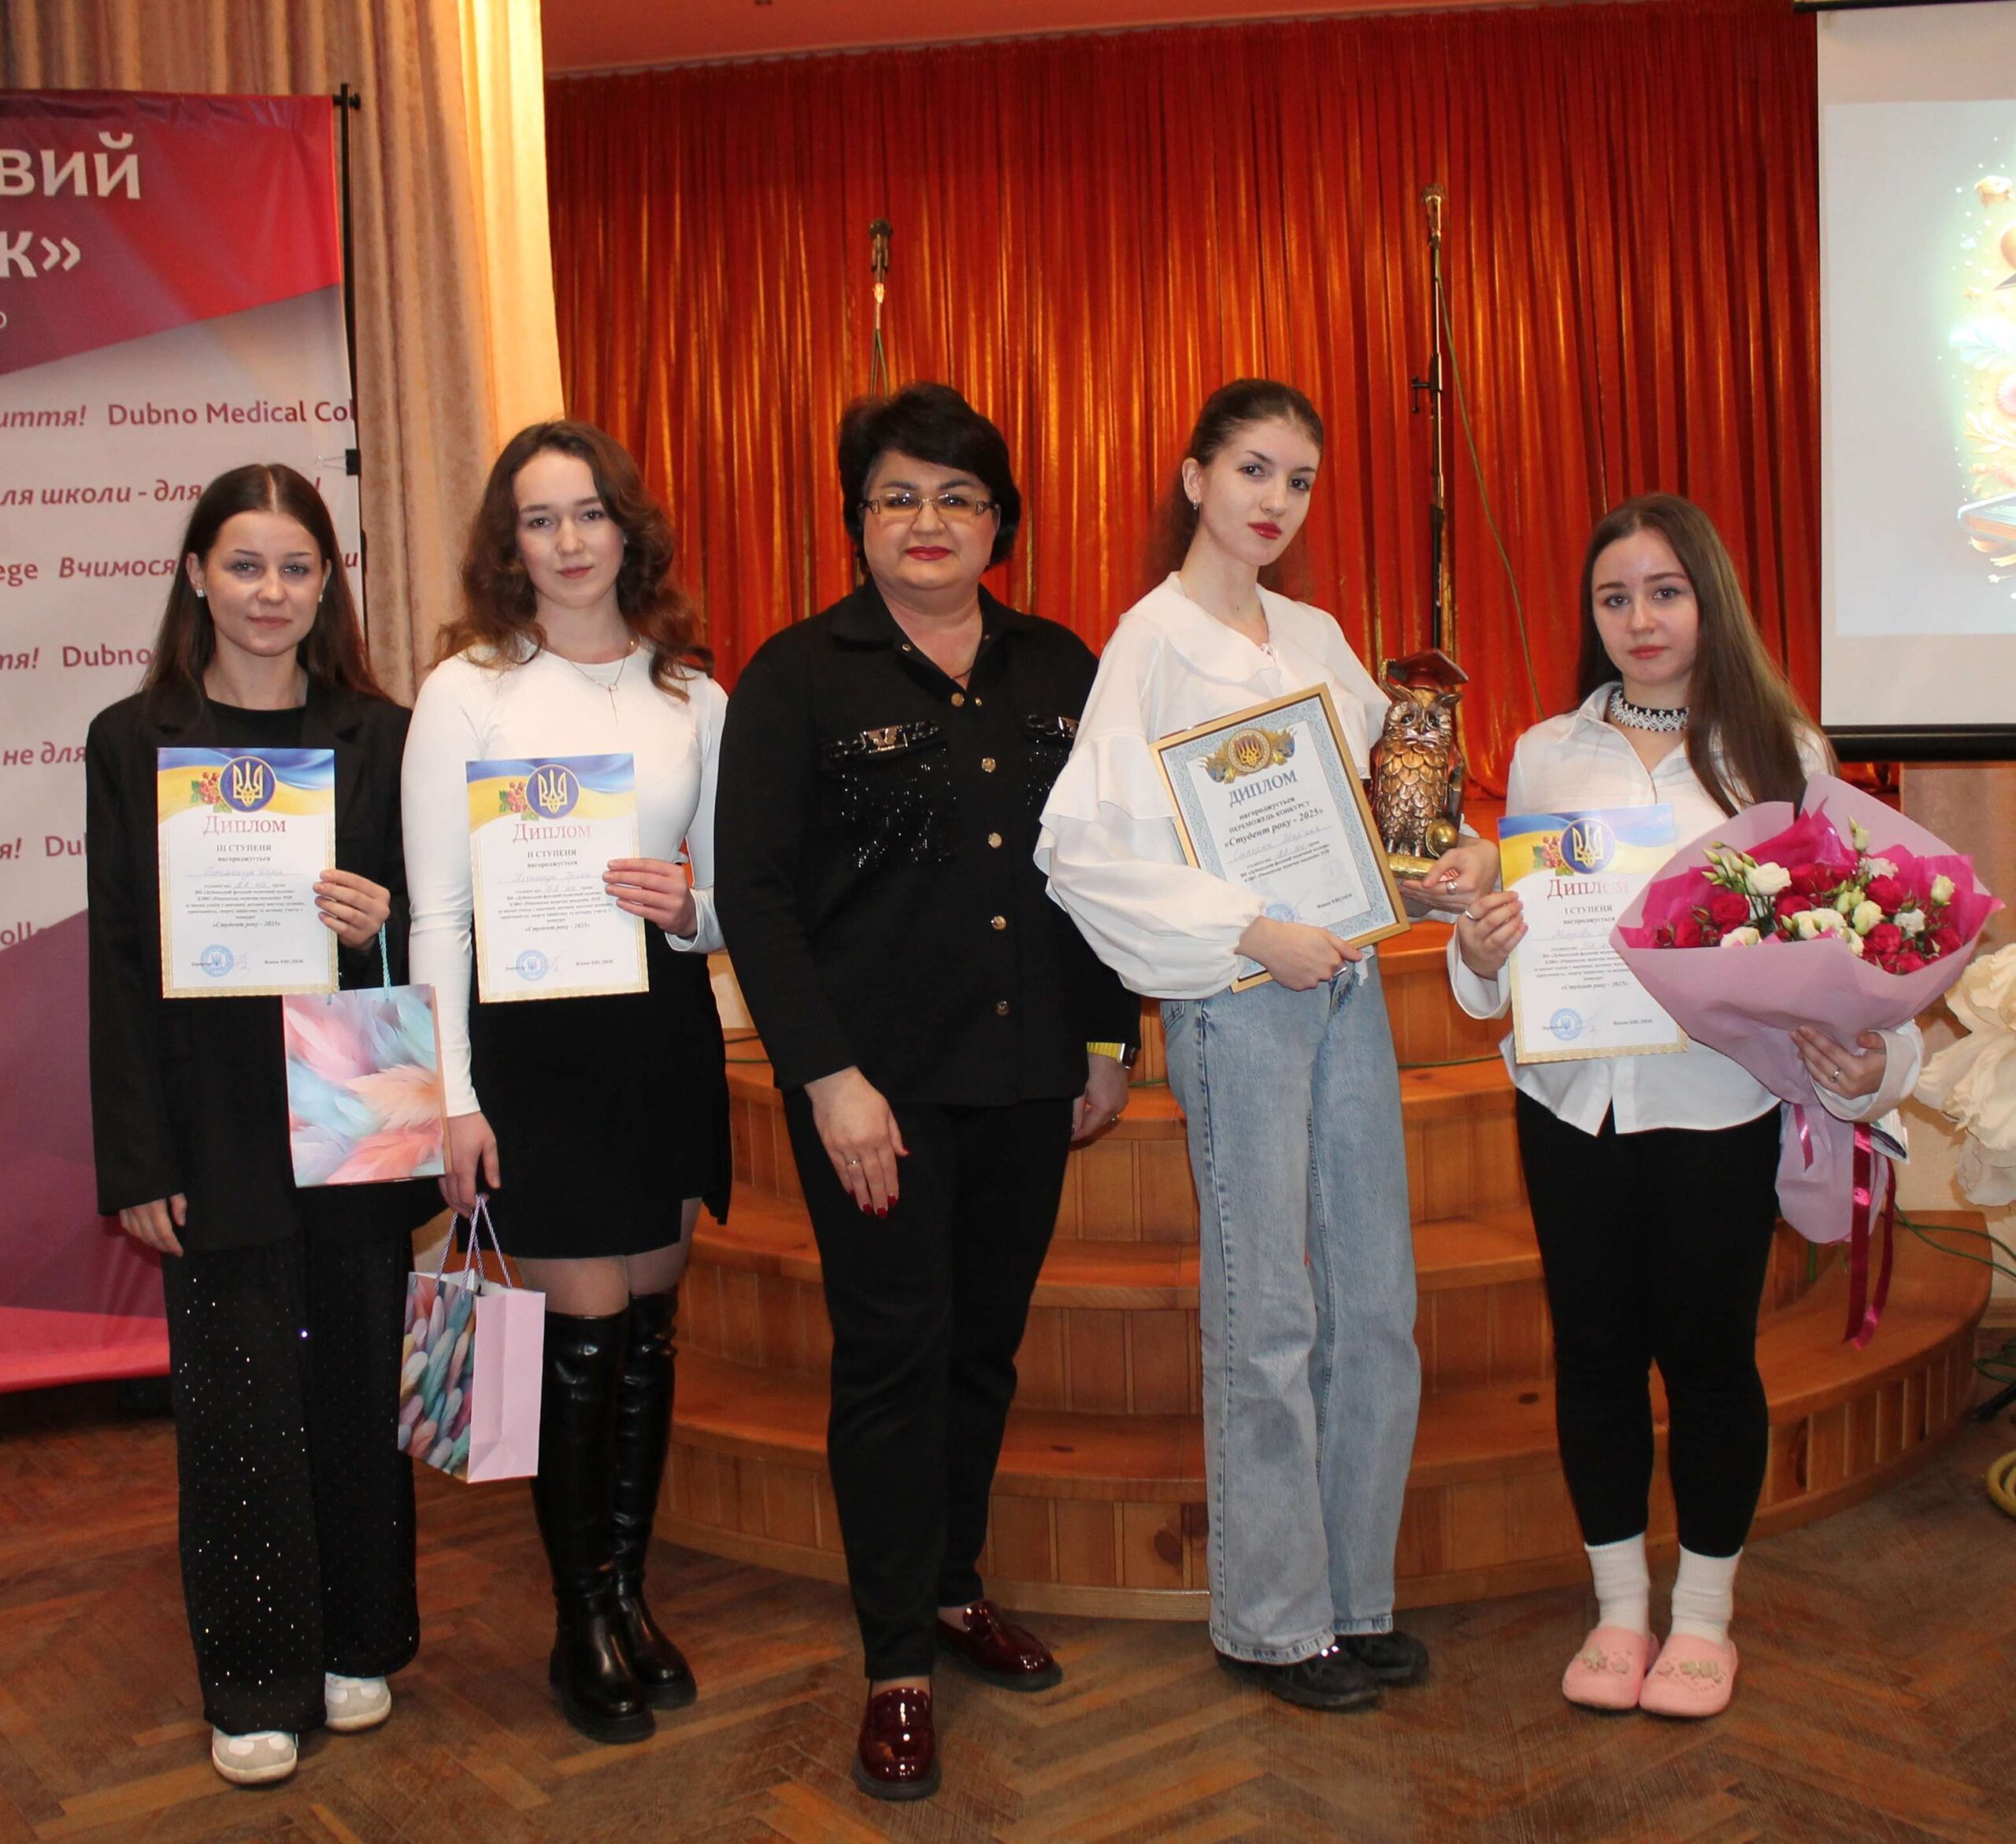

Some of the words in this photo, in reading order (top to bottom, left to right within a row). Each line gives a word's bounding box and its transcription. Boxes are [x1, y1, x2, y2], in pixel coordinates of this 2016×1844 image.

[108, 402, 198, 426] Dubno
[206, 400, 308, 424] Medical
[41, 487, 132, 505] школи
[153, 479, 202, 502] для
[59, 557, 177, 578] Вчимося
[62, 643, 153, 668] Dubno
[3, 749, 34, 766] не
[40, 742, 87, 765] для
[1228, 769, 1298, 809] ДИПЛОМ
[1228, 813, 1275, 833] ПЕРЕМОЖЕЦЬ
[1275, 801, 1310, 817] КОНКУРСУ
[1239, 796, 1295, 820] нагороджується
[1225, 826, 1270, 848] «Студент
[1272, 819, 1292, 834] року
[527, 860, 579, 868] нагороджується
[536, 849, 577, 857] СТУПЕНЯ
[1570, 905, 1613, 914] СТУПЕНЯ
